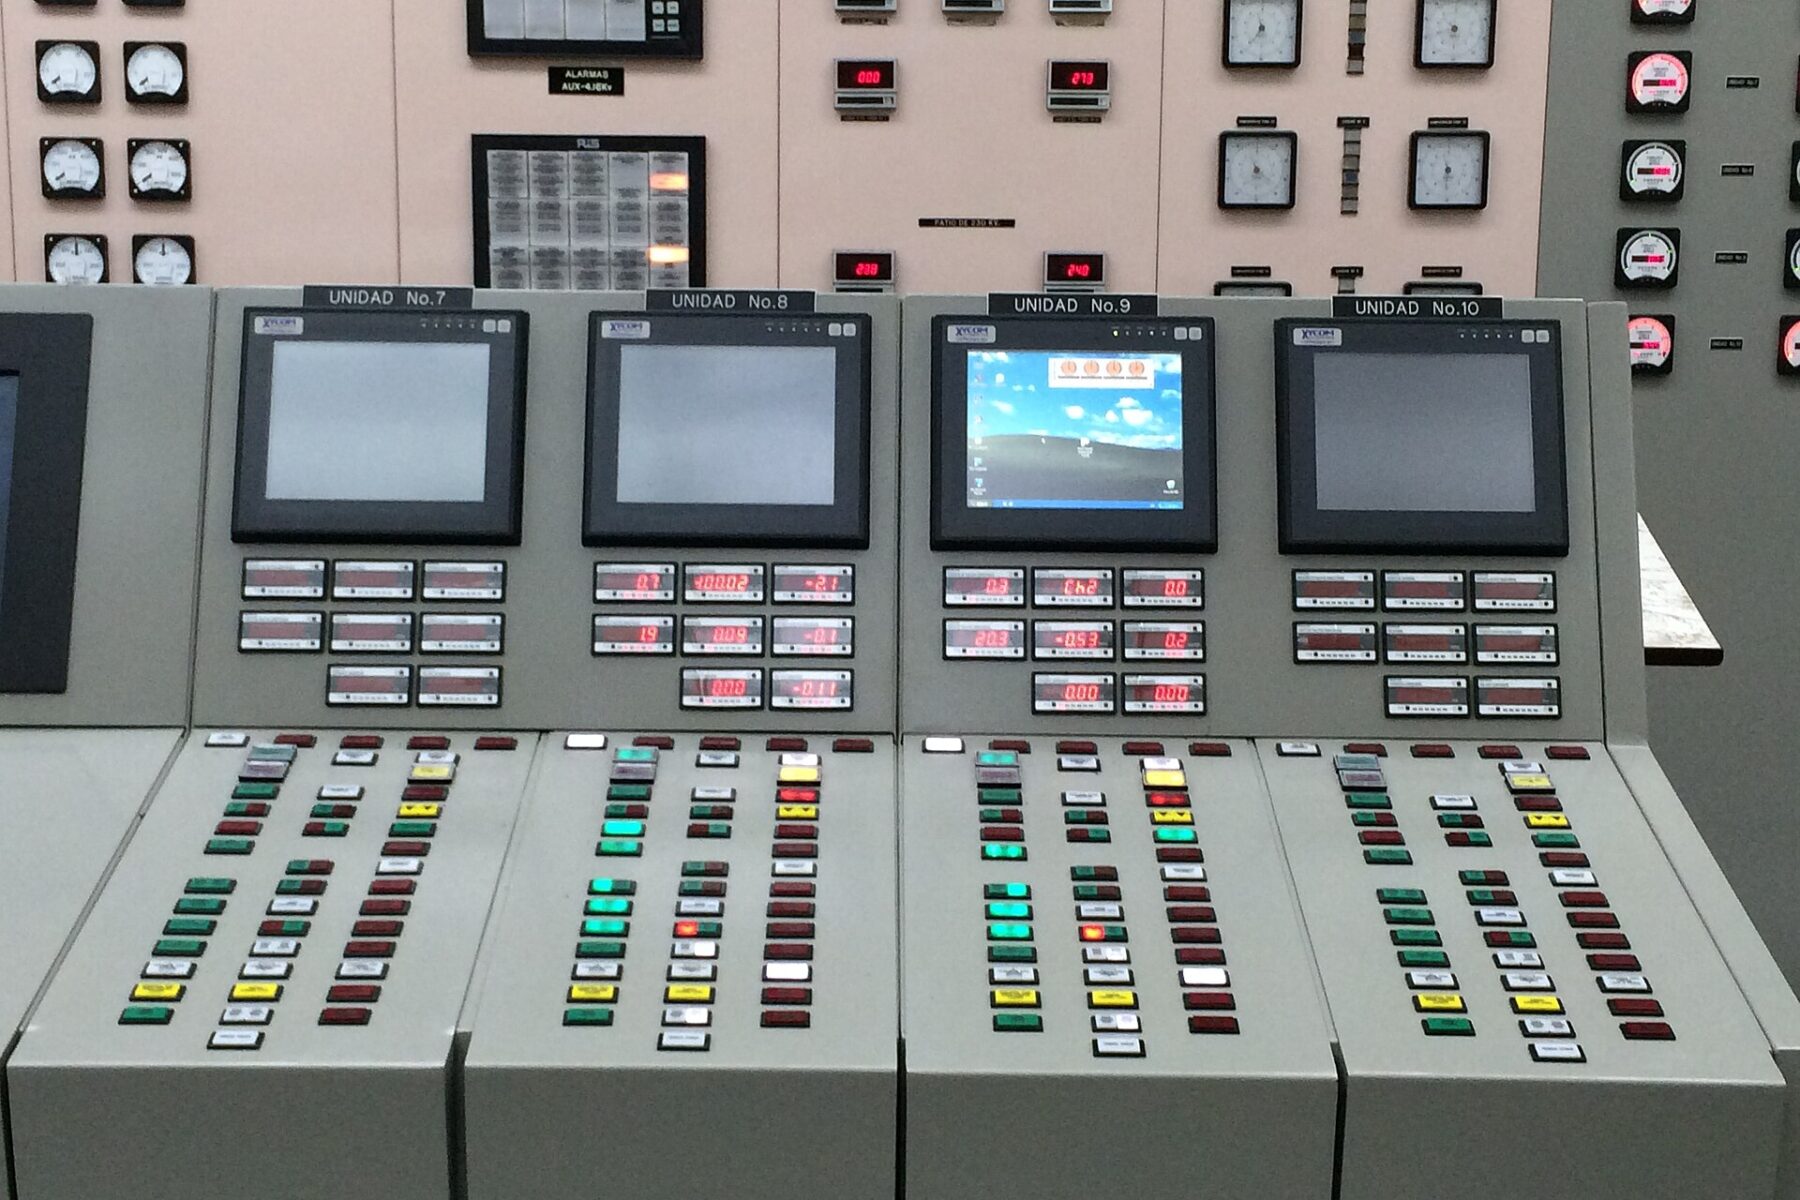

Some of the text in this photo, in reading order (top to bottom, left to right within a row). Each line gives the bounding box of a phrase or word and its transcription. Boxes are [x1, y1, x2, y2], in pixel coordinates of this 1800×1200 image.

[329, 289, 446, 306] UNIDAD No.7
[672, 293, 788, 310] UNIDAD No.8
[1014, 297, 1131, 313] UNIDAD No.9
[1355, 300, 1479, 316] UNIDAD No.10
